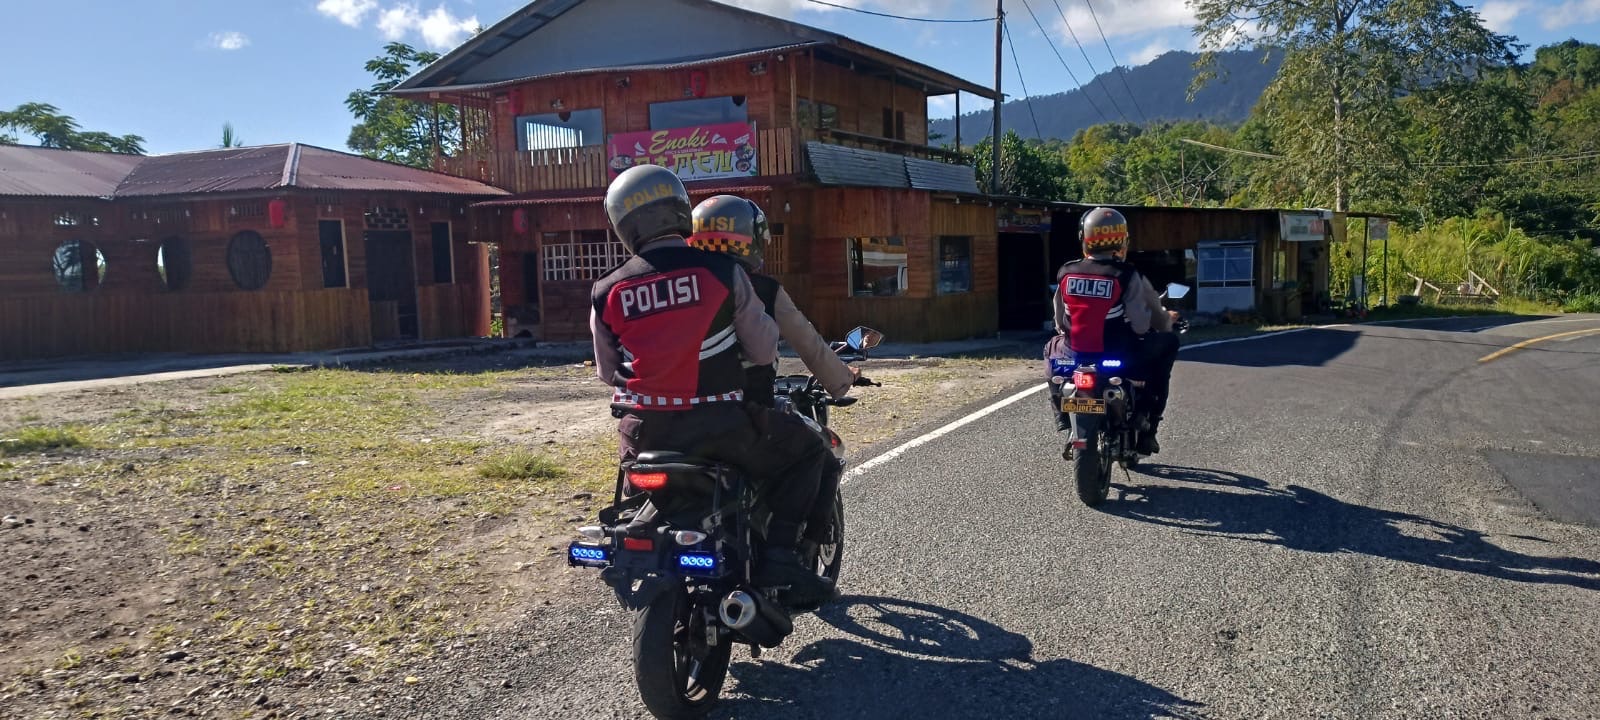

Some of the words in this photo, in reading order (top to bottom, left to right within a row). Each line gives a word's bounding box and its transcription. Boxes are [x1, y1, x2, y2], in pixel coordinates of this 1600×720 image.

[650, 128, 710, 155] Enoki
[623, 183, 673, 209] POLISI
[620, 275, 700, 317] POLISI
[1068, 279, 1111, 297] POLISI
